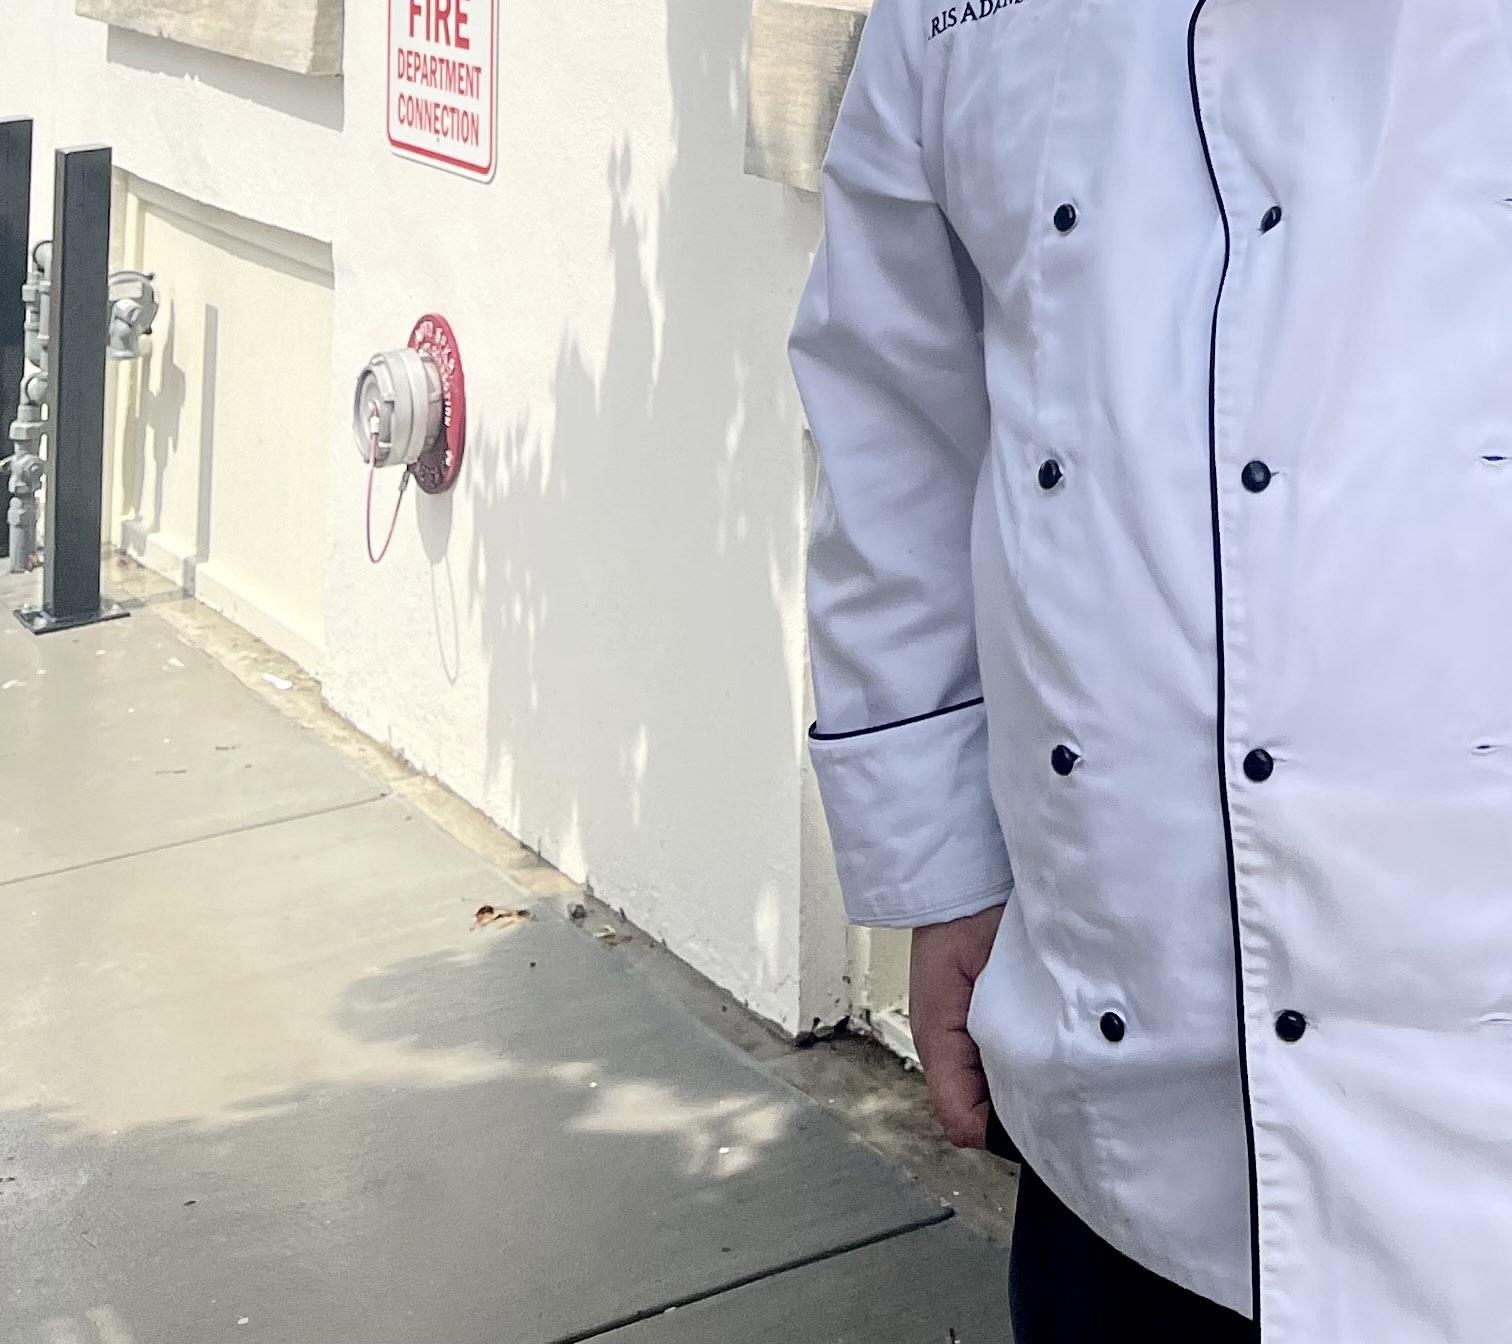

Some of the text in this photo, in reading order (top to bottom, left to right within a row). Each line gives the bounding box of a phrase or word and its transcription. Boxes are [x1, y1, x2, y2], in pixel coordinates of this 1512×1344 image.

[928, 6, 958, 40] RIS
[397, 47, 482, 101] DEPARTMENT
[397, 93, 480, 147] CONNECTION
